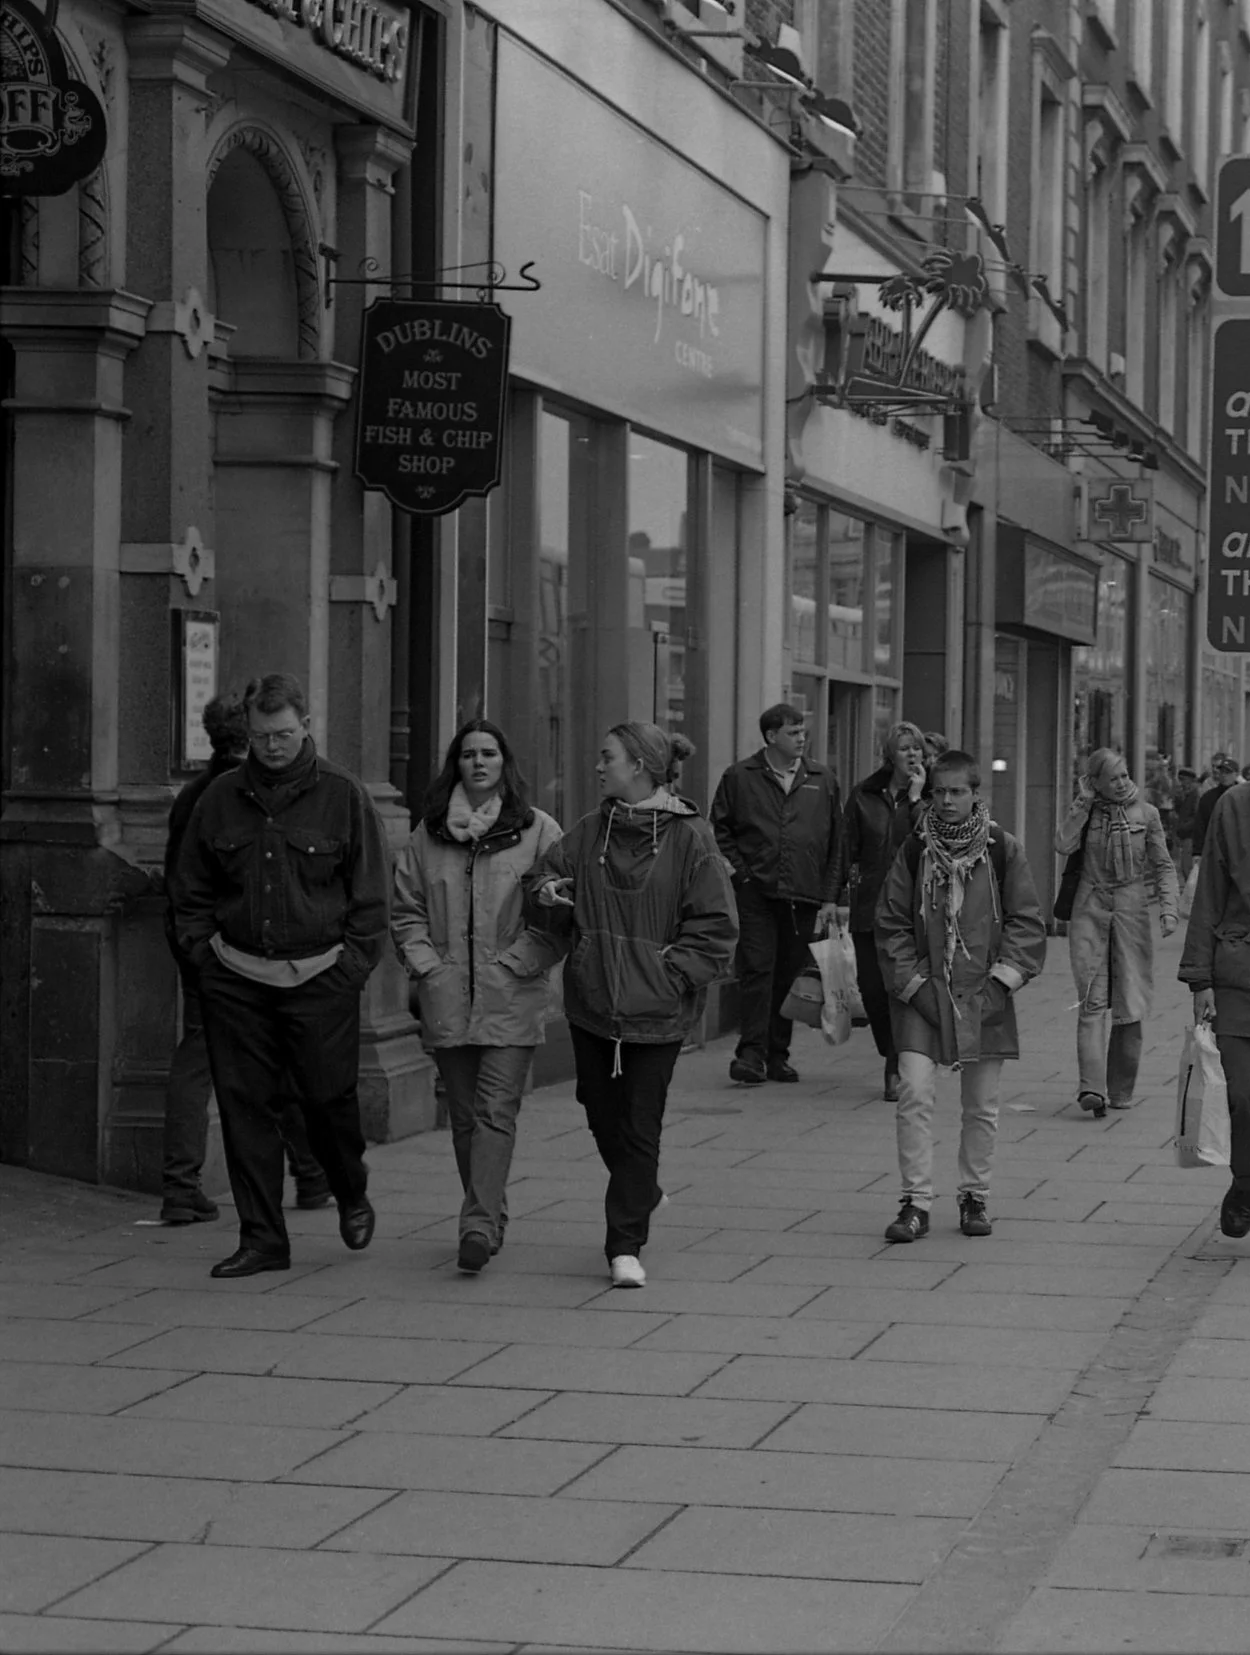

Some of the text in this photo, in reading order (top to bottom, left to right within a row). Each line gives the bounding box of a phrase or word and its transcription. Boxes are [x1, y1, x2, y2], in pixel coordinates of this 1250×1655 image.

[0, 10, 44, 76] HIPS
[375, 318, 494, 360] DUBLINS
[402, 370, 463, 391] MOST
[387, 397, 478, 422] FAMOUS
[364, 425, 493, 449] FISH & CHIP
[398, 454, 456, 475] SHOP
